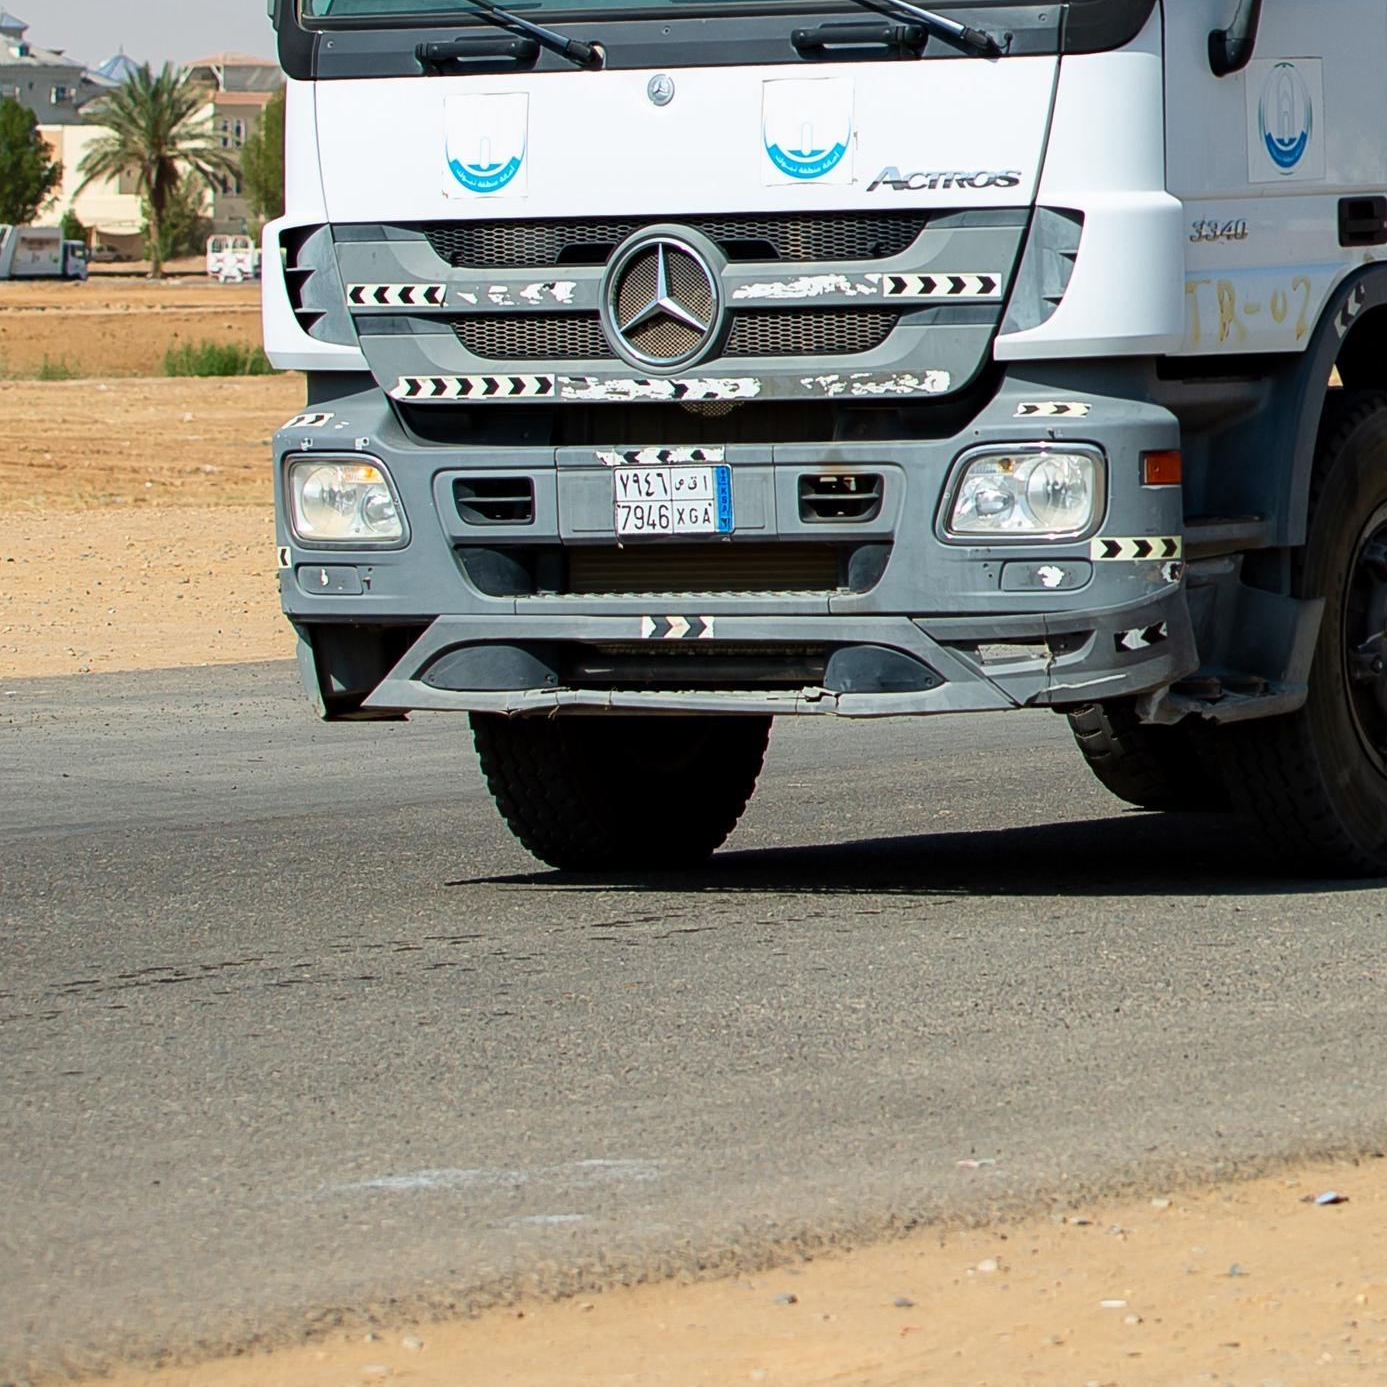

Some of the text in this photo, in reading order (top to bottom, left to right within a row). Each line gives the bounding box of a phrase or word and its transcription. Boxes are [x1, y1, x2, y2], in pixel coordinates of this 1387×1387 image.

[1189, 218, 1249, 243] 3340
[620, 472, 668, 498] ٧٩٤٦
[621, 504, 711, 531] 7946 XGA
